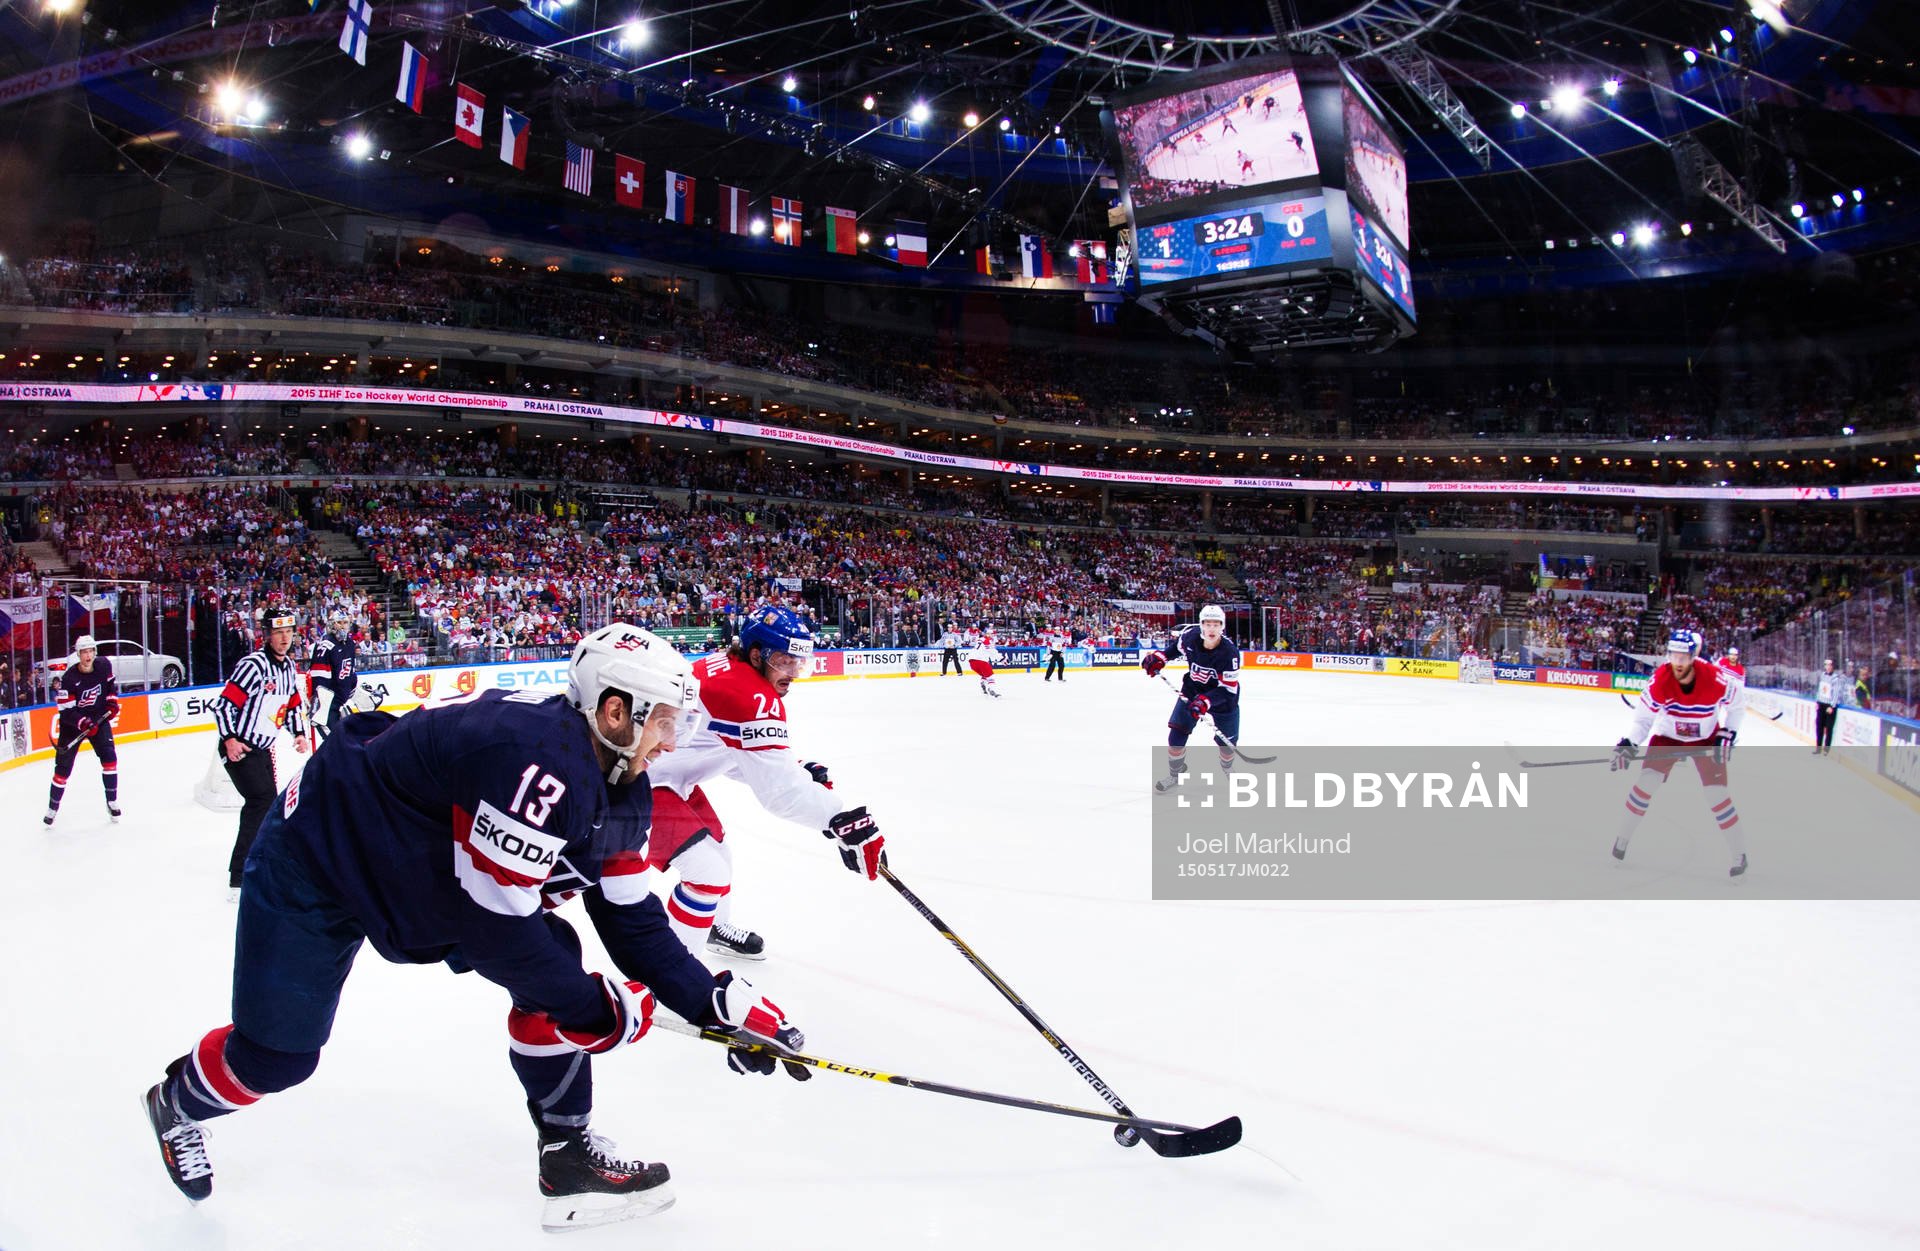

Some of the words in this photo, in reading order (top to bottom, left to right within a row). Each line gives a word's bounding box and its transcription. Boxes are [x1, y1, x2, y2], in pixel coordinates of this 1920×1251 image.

[1203, 216, 1254, 243] 3:24
[1287, 216, 1304, 238] 0
[1158, 238, 1171, 258] 1
[23, 388, 72, 398] OSTRAVA
[291, 389, 316, 398] 2015
[318, 390, 342, 399] IIHF
[344, 391, 363, 399] Ice
[365, 391, 403, 402] Hockey
[406, 393, 435, 403] World
[438, 394, 508, 408] Championship
[524, 401, 556, 412] PRAHA
[562, 404, 603, 416] OSTRAVA
[760, 428, 777, 436] 2015
[778, 430, 794, 439] IIHF
[795, 432, 807, 441] Ice
[808, 434, 832, 446] Hockey
[833, 438, 851, 448] World
[852, 441, 896, 456] Championship
[904, 450, 923, 460] PRAHA
[927, 453, 957, 464] OSTRAVA
[1098, 471, 1112, 479] IIHF
[1127, 474, 1152, 482] Hockey
[1174, 476, 1223, 485] Championship
[1262, 480, 1293, 488] OSTRAVA
[1519, 484, 1567, 492] Championship
[1605, 486, 1635, 494] OSTRAVA
[621, 632, 651, 650] USA
[863, 653, 904, 665] TISSOT
[1012, 652, 1038, 665] MEN
[1330, 655, 1371, 666] TISSOT
[1412, 659, 1447, 668] Raiffeisen
[1546, 670, 1599, 687] KRUŠOVICE
[753, 692, 781, 719] 24
[742, 725, 789, 740] ŠKODA
[508, 763, 567, 827] 13
[473, 813, 554, 867] ŠKODA
[900, 889, 935, 922] BAUER
[826, 1062, 877, 1079] CCM
[1059, 1045, 1126, 1112] SUPREME
[604, 1171, 625, 1180] CCM
